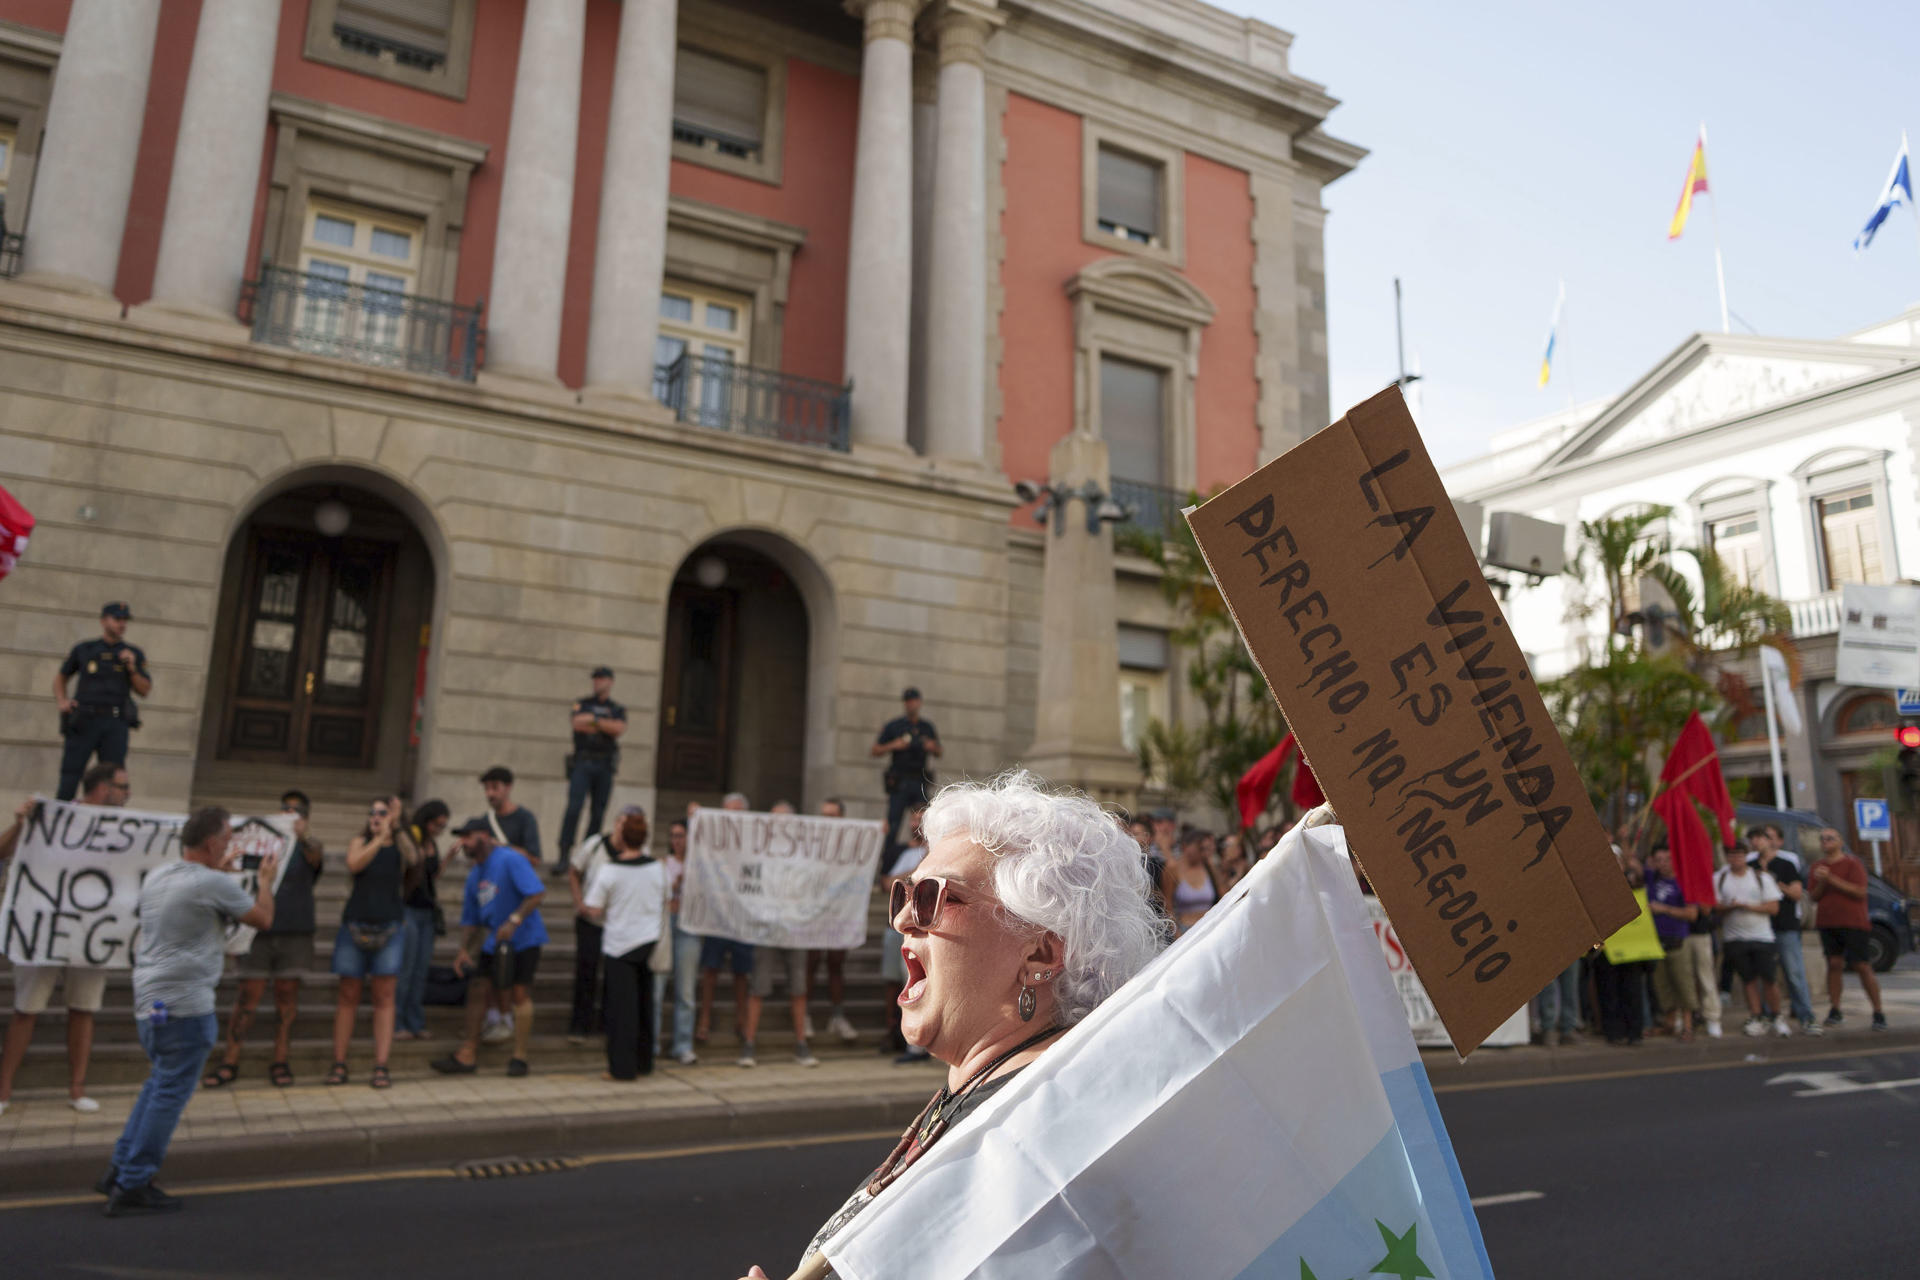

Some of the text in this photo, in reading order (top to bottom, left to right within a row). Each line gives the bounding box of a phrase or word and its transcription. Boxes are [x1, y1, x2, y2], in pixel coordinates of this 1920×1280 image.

[1360, 449, 1436, 568] LA
[1225, 494, 1370, 733] DERECHO,
[1349, 728, 1408, 804] NO
[1391, 642, 1504, 828] ES UN
[1862, 804, 1883, 828] P
[13, 861, 114, 913] NO
